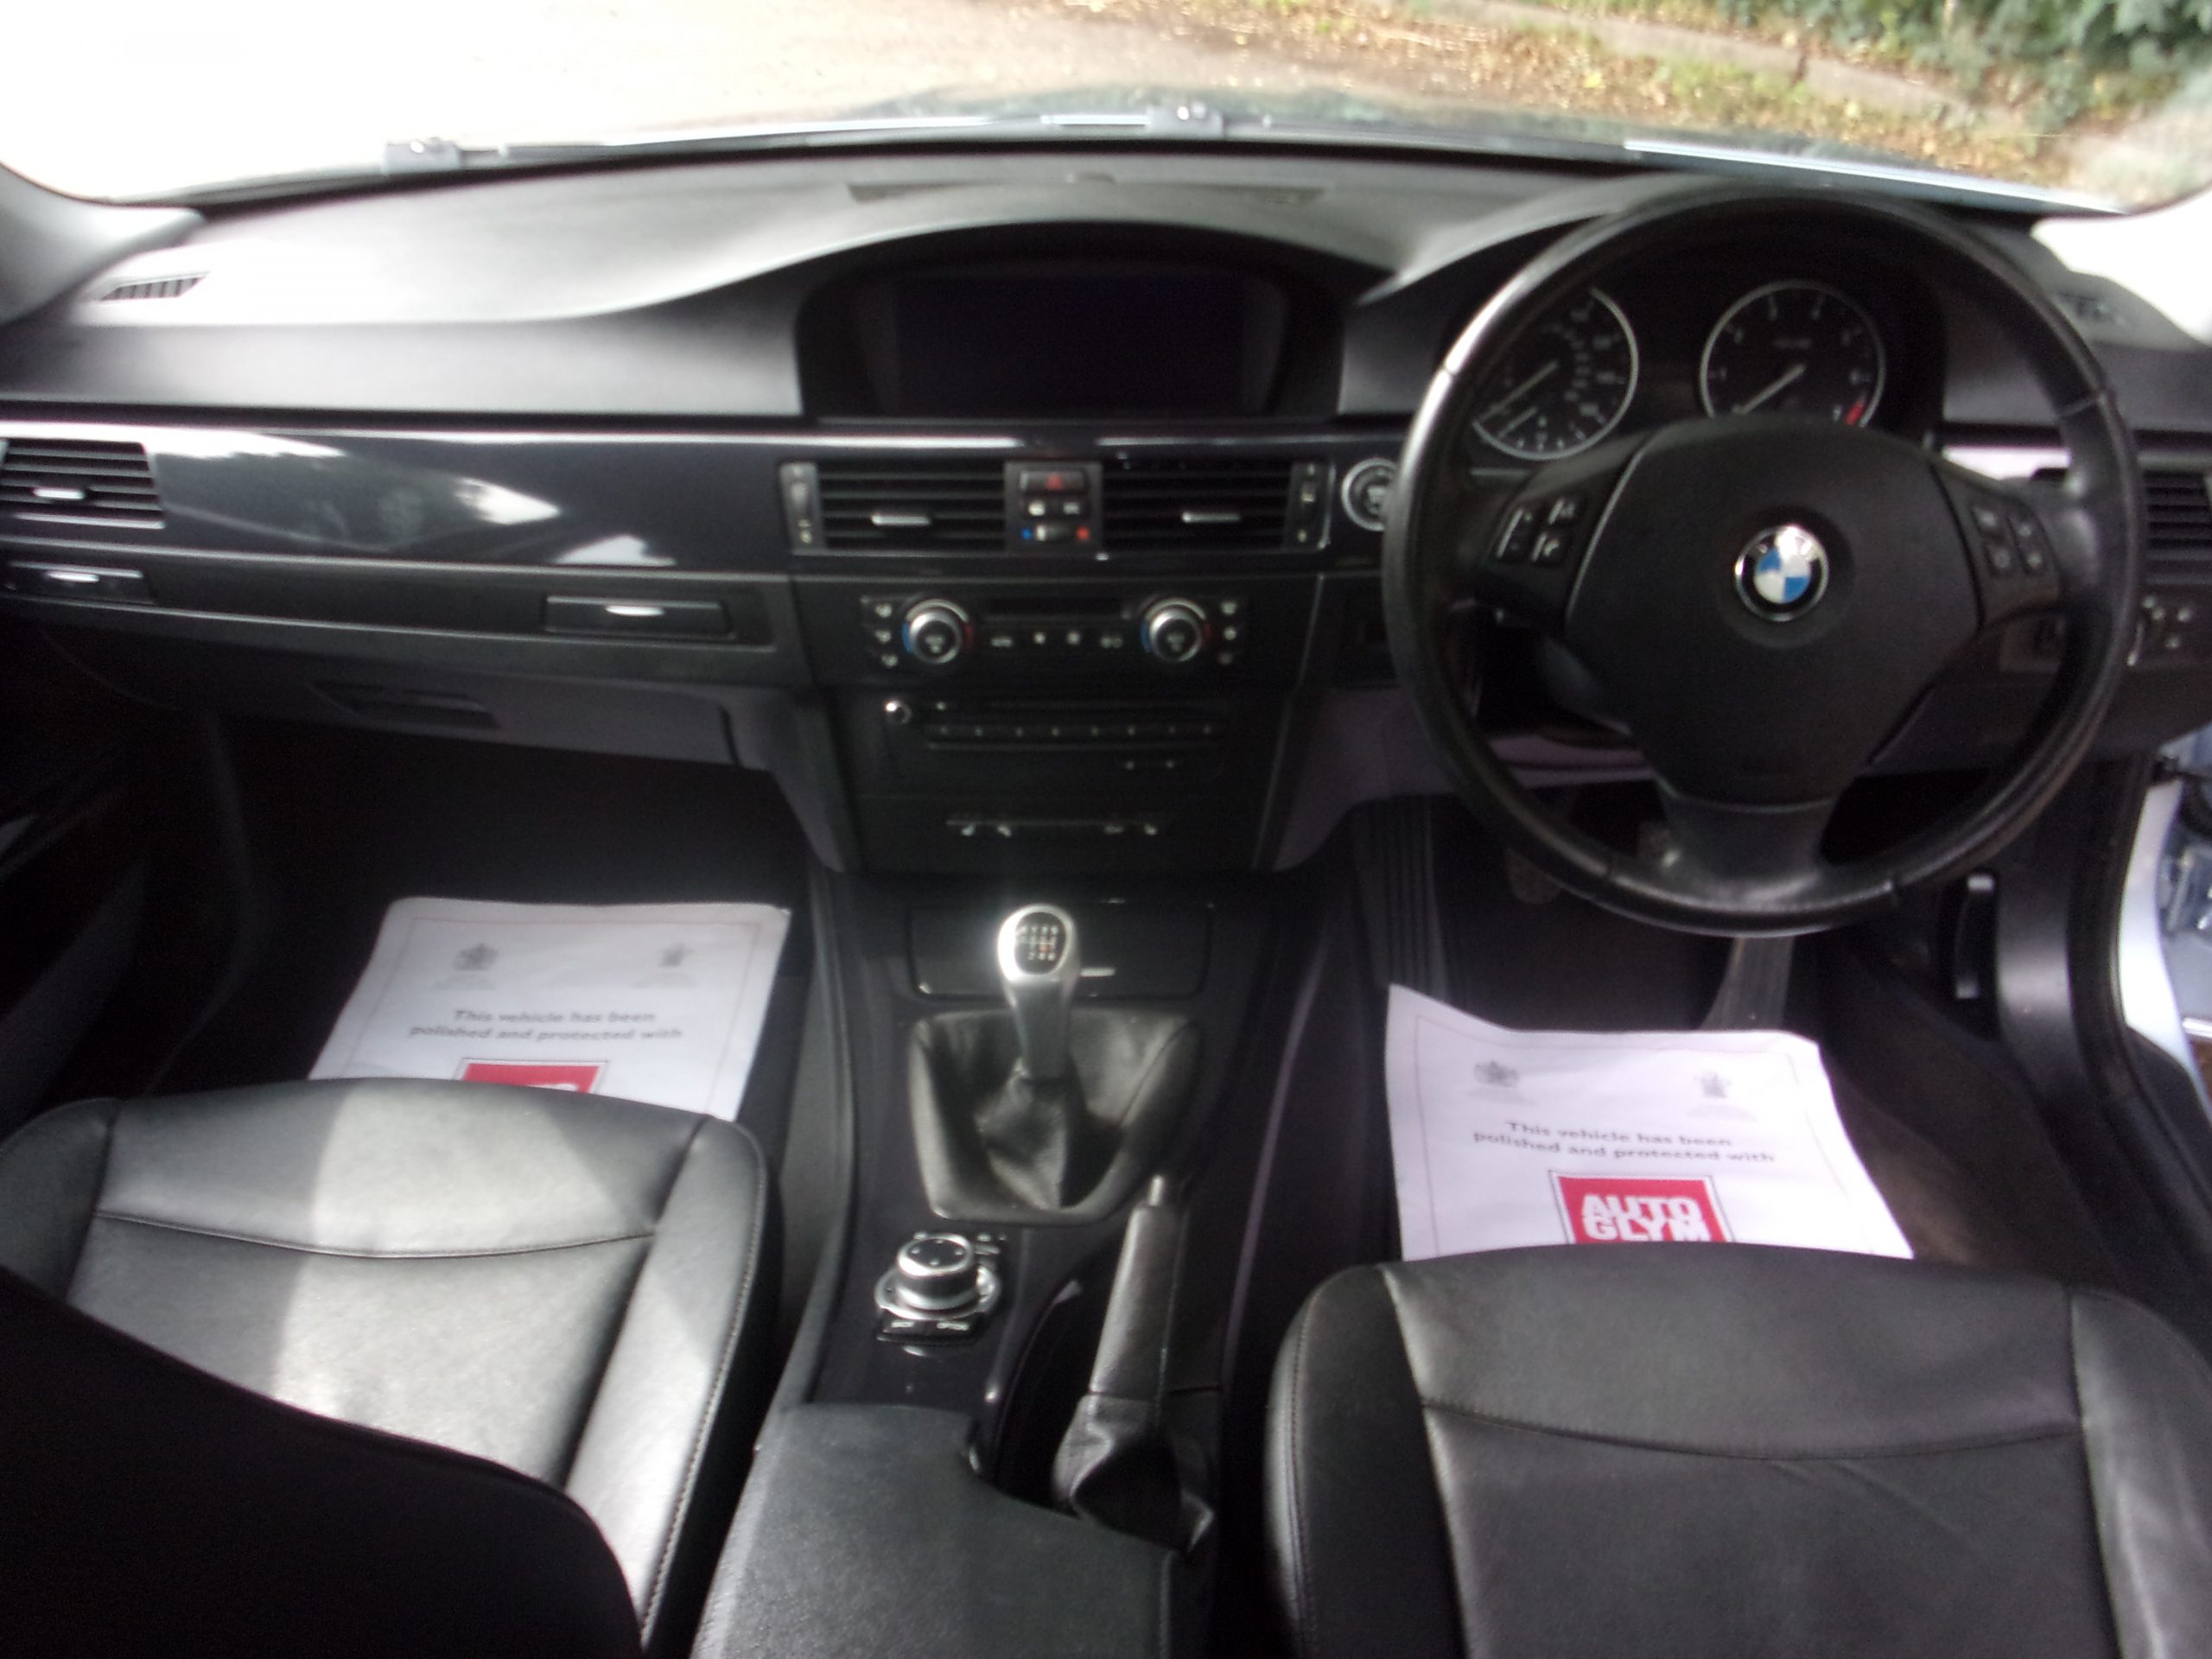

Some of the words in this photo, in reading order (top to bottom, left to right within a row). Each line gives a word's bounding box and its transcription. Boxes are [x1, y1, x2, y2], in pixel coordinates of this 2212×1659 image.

[454, 1009, 493, 1023] This
[498, 1011, 563, 1024] vehicle
[570, 1011, 601, 1024] has
[607, 1011, 657, 1024] been
[410, 1024, 492, 1040] polished
[496, 1027, 532, 1039] and
[537, 1027, 635, 1042] protected
[640, 1027, 683, 1039] with
[1506, 1121, 1550, 1136] This
[1557, 1128, 1630, 1143] vehicle
[1637, 1133, 1673, 1145] has
[1678, 1135, 1732, 1147] been
[1473, 1131, 1560, 1154] polished
[1568, 1145, 1607, 1157] and
[1613, 1147, 1719, 1161] protected
[1726, 1152, 1775, 1163] with
[1582, 1194, 1700, 1219] AUTO
[1583, 1217, 1712, 1242] GLYM
